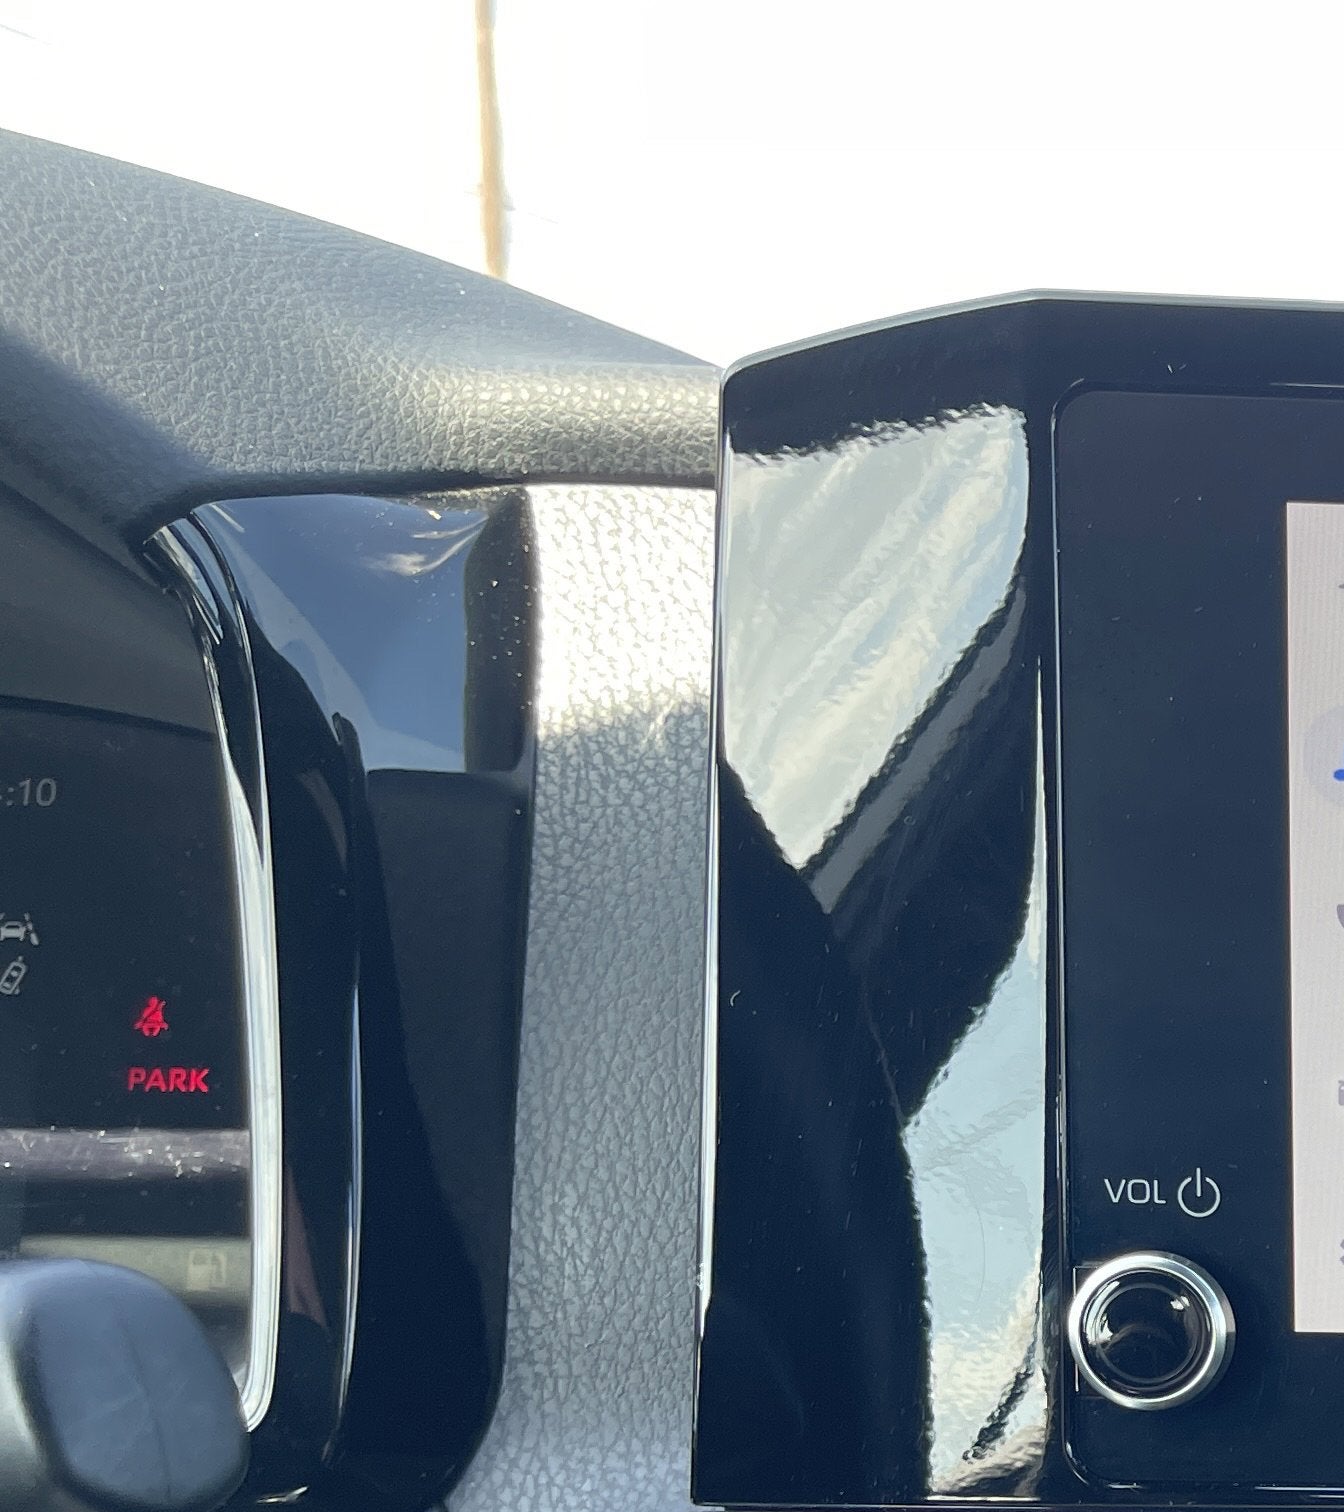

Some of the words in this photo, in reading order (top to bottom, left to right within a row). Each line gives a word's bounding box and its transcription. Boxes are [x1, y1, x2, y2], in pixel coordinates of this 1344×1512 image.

[0, 777, 57, 807] :10
[128, 1067, 209, 1093] PARK
[1104, 1178, 1166, 1204] VOL
